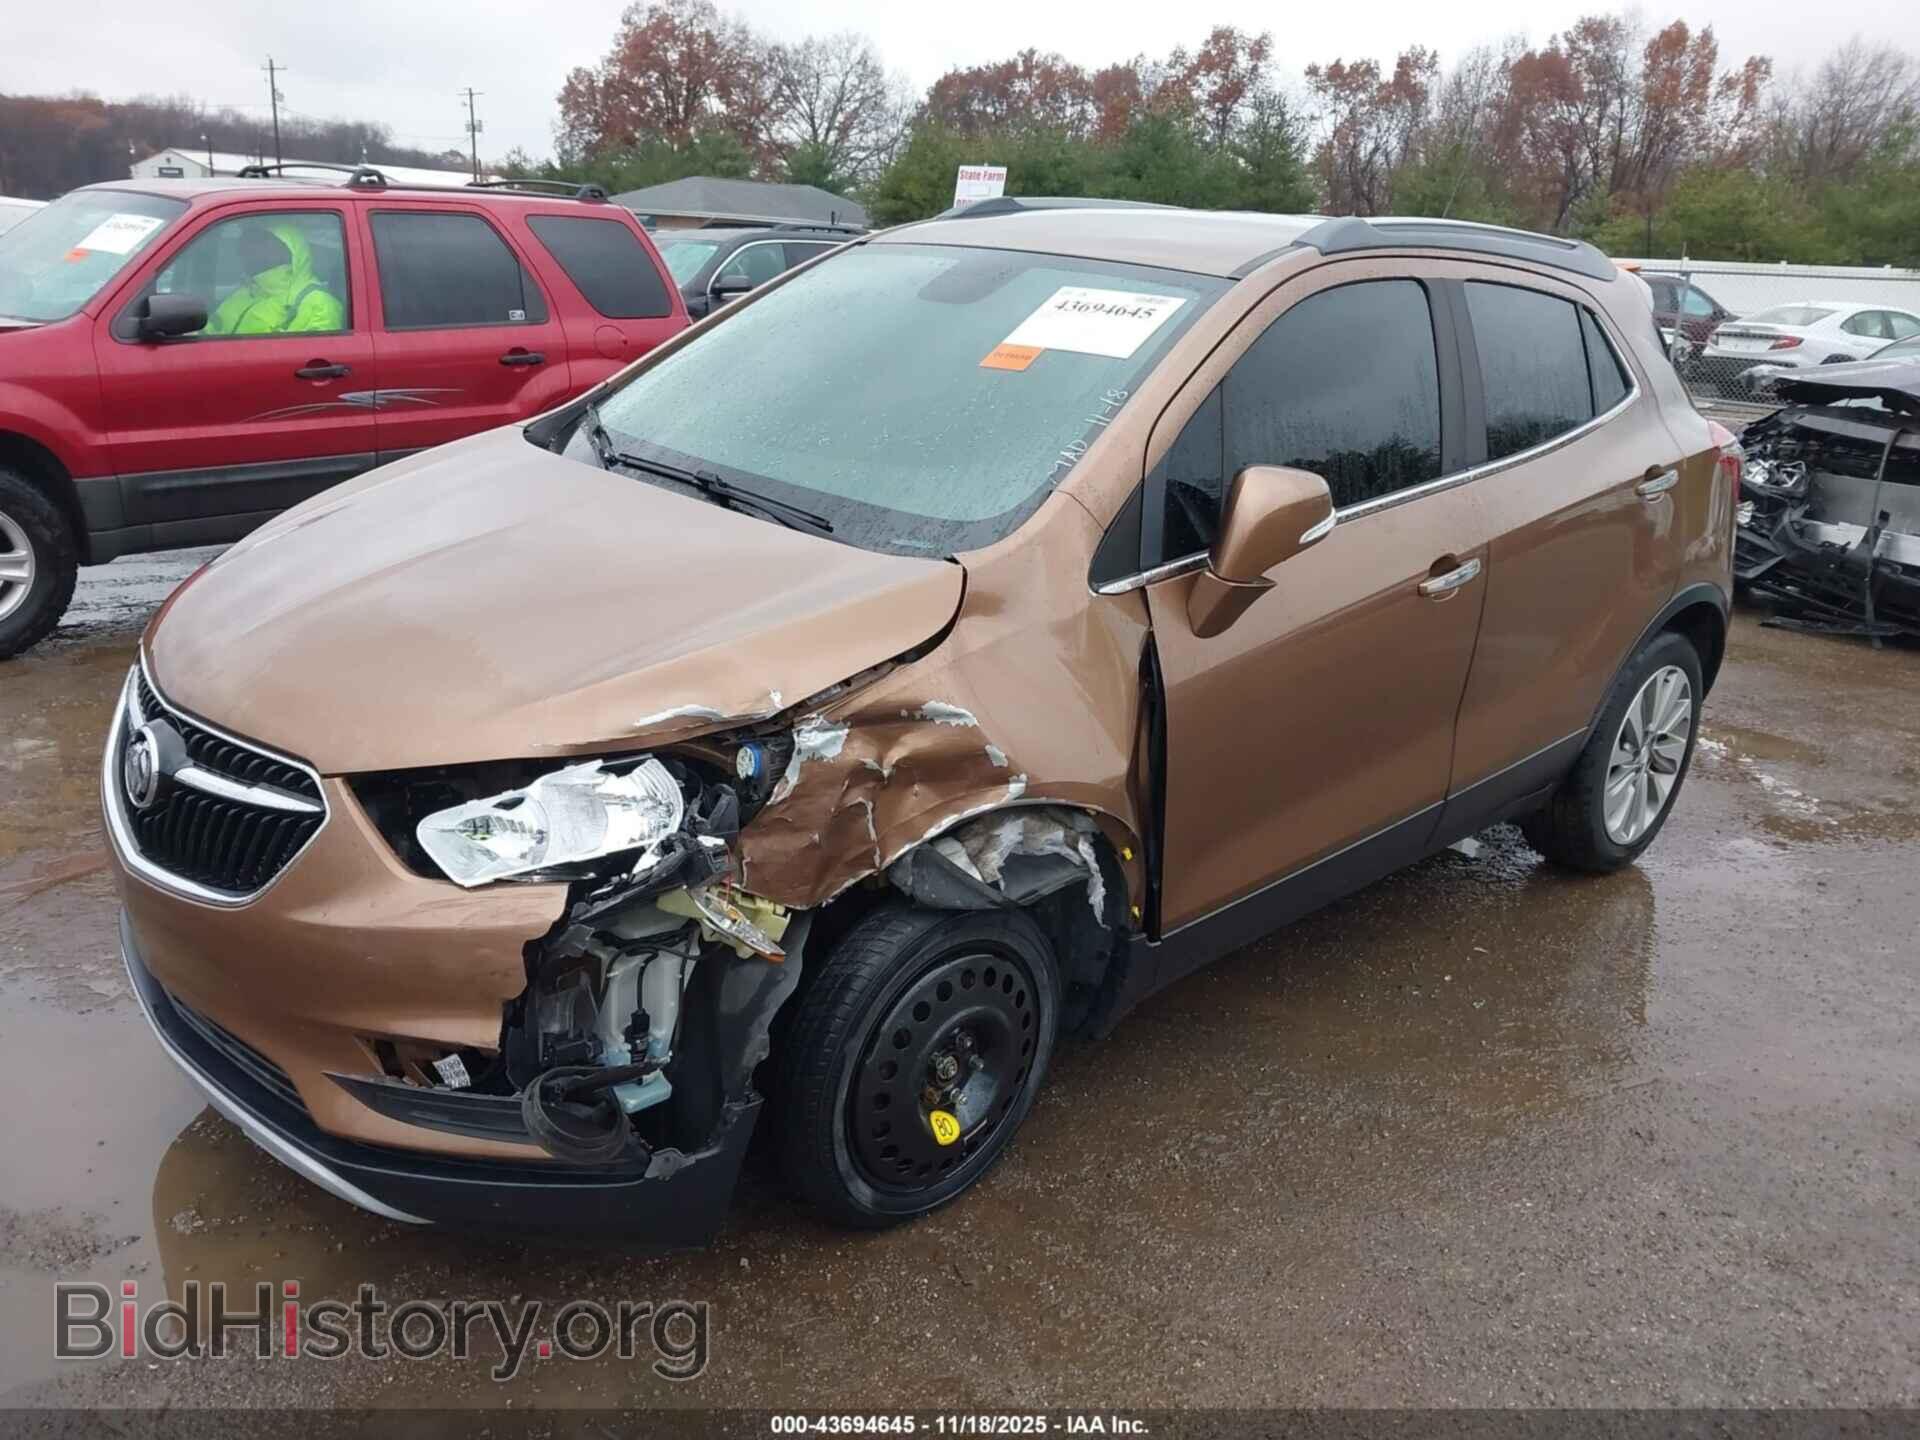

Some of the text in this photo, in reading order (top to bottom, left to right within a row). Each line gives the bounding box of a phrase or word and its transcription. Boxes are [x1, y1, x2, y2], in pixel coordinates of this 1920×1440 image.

[959, 169, 1005, 181] State Farm
[1055, 300, 1157, 320] 43694645
[935, 1117, 953, 1136] 80
